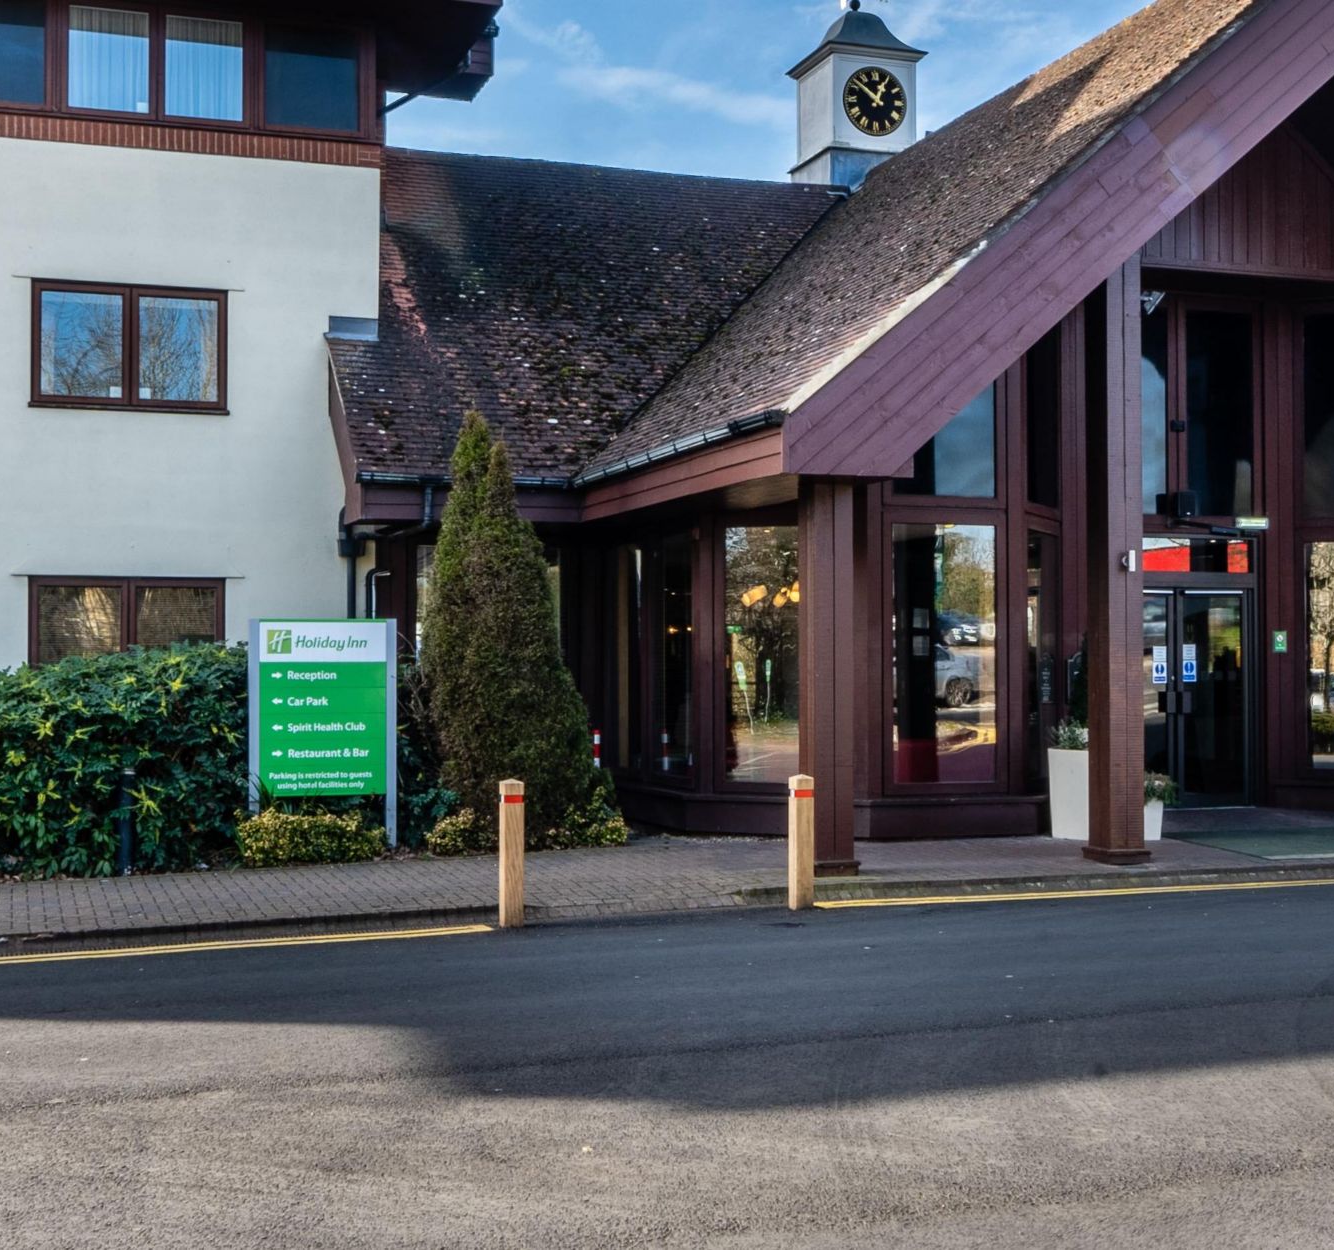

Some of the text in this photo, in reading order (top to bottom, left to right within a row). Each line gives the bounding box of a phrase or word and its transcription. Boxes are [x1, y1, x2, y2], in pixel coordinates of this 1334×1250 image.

[295, 635, 368, 651] Holiday Inn
[287, 670, 337, 682] Reception
[287, 696, 328, 706] Car Park
[287, 722, 366, 733] Spirit Health Club
[288, 748, 369, 758] Restaurant & Bar
[269, 772, 297, 781] Parking
[305, 771, 339, 779] restricted
[349, 771, 372, 779] guests
[277, 782, 297, 790] using
[318, 781, 348, 789] facilities
[349, 781, 364, 789] only
